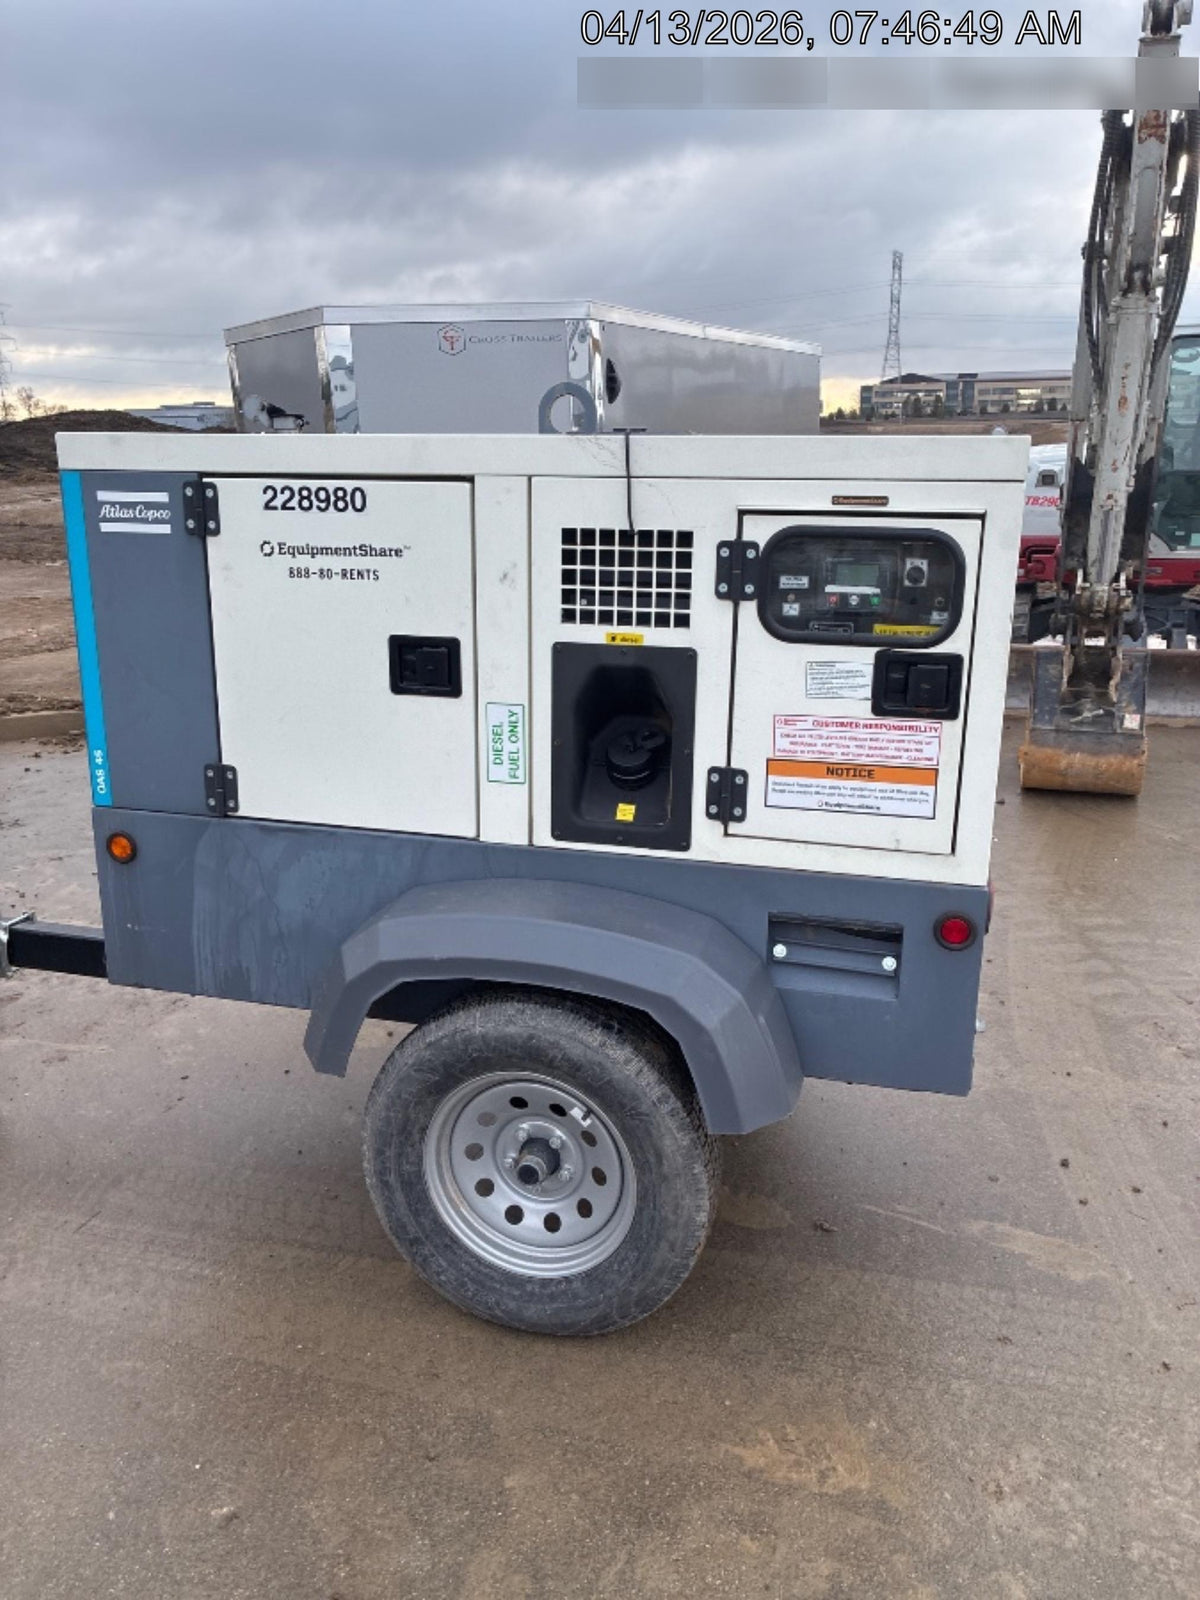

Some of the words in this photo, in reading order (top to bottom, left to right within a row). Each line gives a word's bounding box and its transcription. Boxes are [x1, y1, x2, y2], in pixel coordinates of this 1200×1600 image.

[262, 485, 367, 513] 228980
[98, 504, 134, 519] Atlas
[135, 504, 171, 522] Copco
[288, 566, 380, 581] 888-80-RENTS
[508, 709, 520, 743] ONLY
[812, 720, 861, 730] CUSTOMER
[492, 722, 504, 765] DIESEL
[508, 748, 520, 779] FUEL
[826, 766, 876, 780] NOTICE
